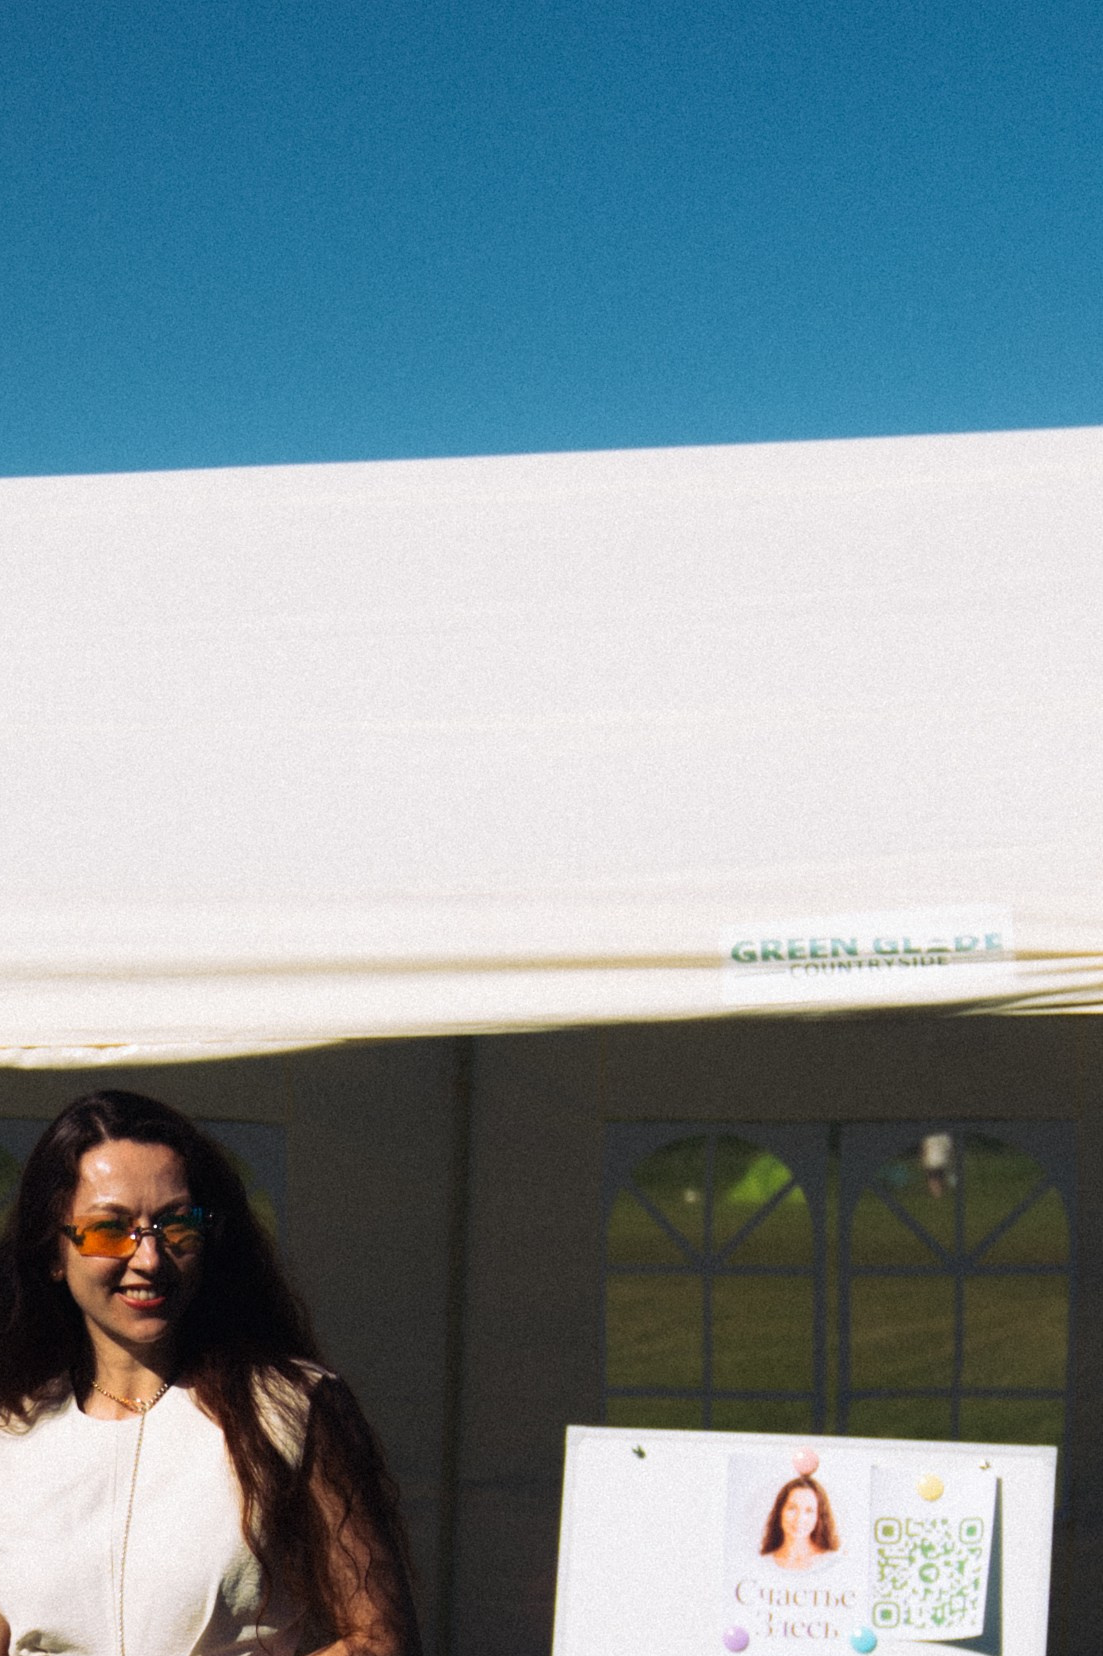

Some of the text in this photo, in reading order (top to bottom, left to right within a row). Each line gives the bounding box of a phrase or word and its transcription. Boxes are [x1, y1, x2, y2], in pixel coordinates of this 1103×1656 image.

[731, 936, 859, 963] GREEN
[790, 953, 950, 978] COUNTRYSIDE
[735, 1578, 857, 1608] Счастье
